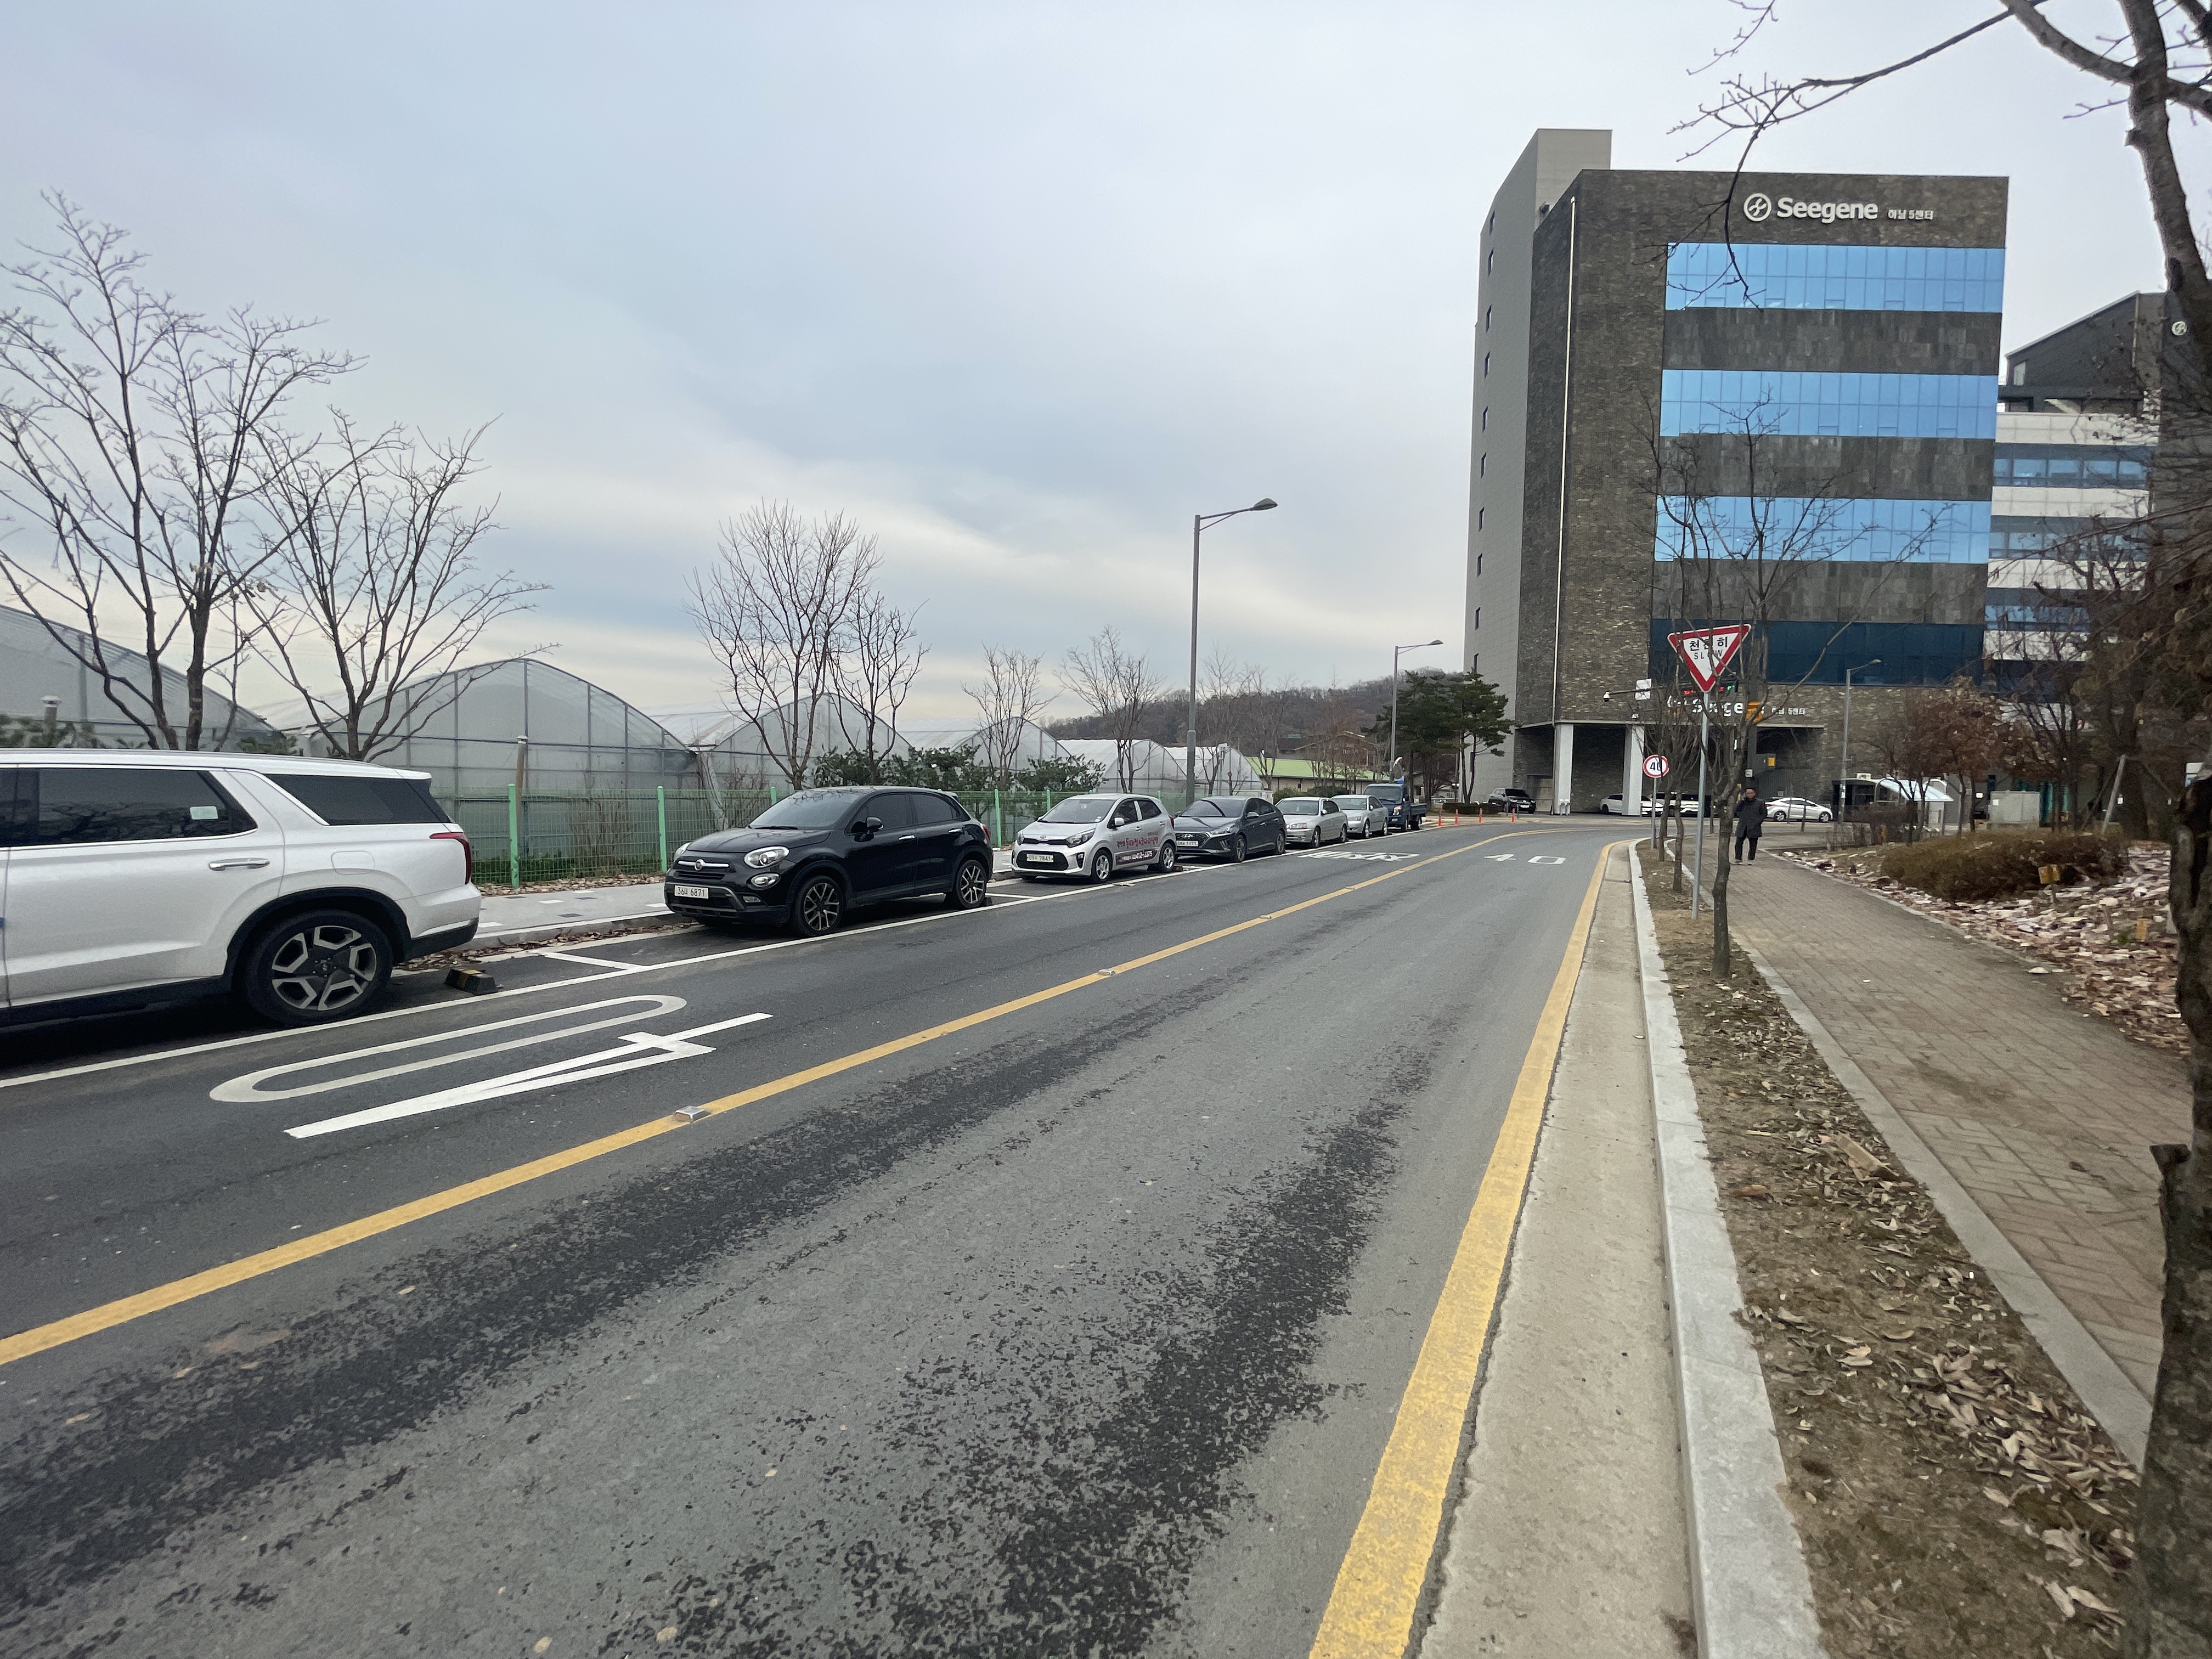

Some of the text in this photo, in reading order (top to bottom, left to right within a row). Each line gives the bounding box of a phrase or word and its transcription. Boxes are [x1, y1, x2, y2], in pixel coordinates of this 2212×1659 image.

[1777, 197, 1878, 224] Seegene
[1694, 650, 1723, 659] SLW
[1650, 762, 1662, 771] 40
[1483, 854, 1566, 865] 40
[690, 888, 705, 897] 6871
